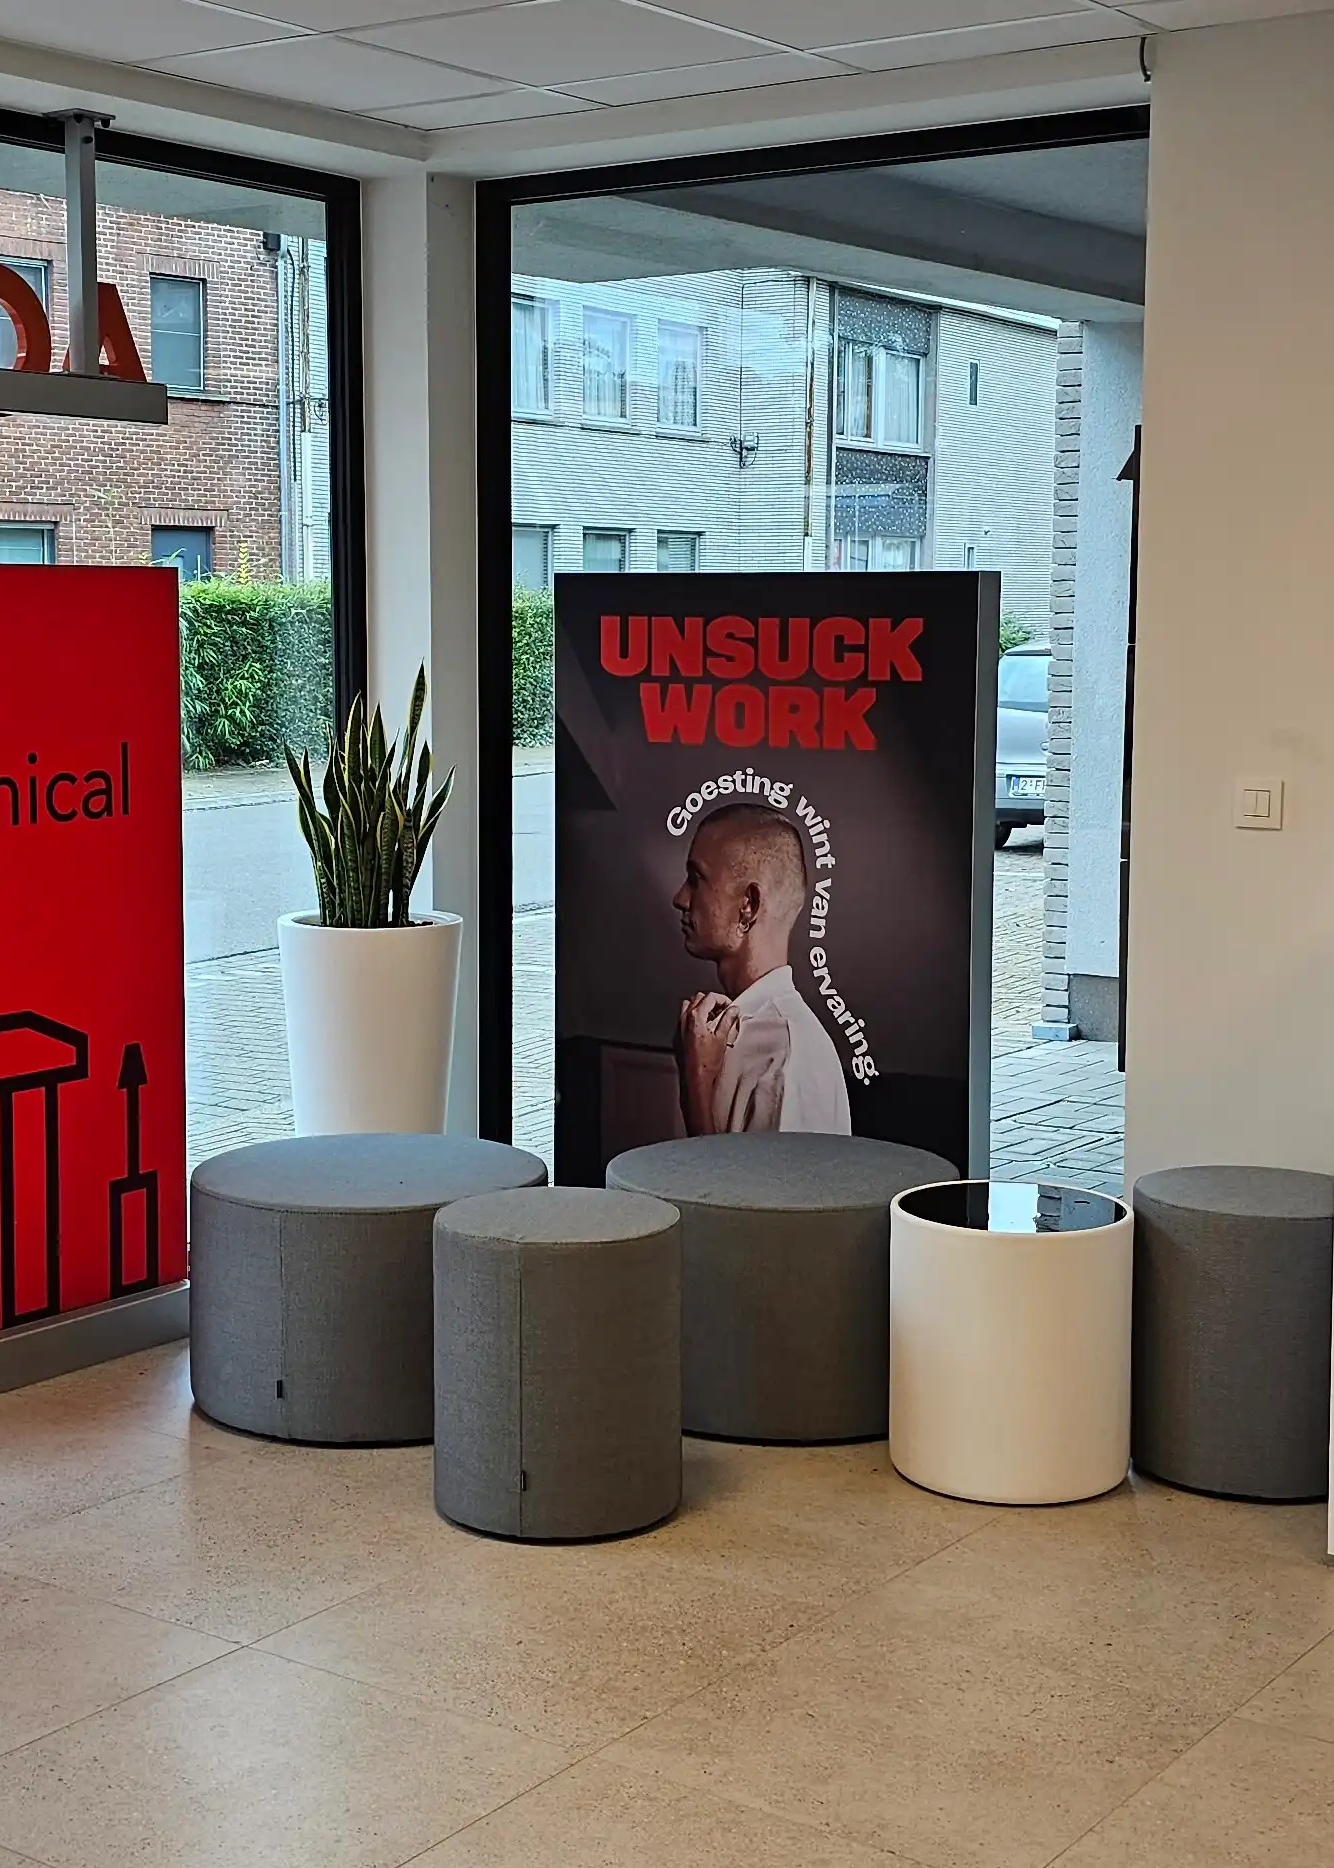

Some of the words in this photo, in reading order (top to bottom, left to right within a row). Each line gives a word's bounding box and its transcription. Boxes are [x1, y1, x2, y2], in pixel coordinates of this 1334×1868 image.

[600, 615, 924, 682] UNSUCK
[640, 682, 877, 750] WORK
[666, 767, 794, 837] Goesting
[795, 795, 836, 869] wint
[809, 877, 832, 939] van
[809, 946, 880, 1086] ervaring.
